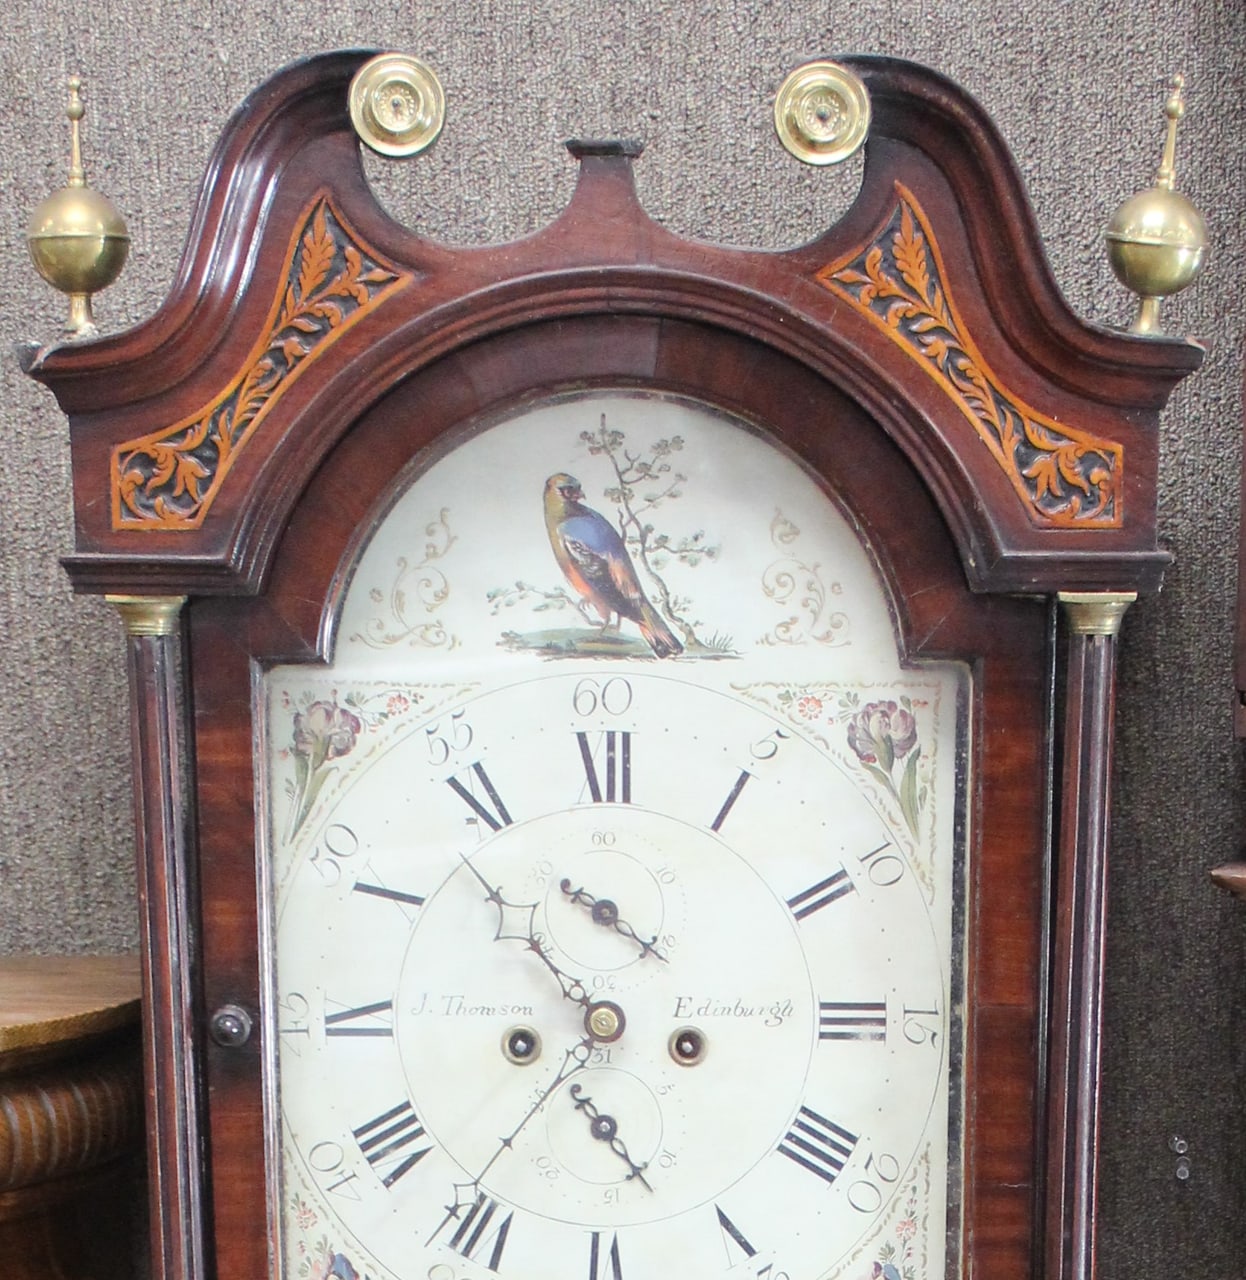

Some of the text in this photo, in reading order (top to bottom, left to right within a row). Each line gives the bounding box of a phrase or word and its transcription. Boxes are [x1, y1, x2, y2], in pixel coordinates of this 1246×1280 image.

[573, 677, 633, 716] 60
[426, 708, 473, 766] 55
[749, 729, 790, 760] 5
[572, 730, 641, 806] XII
[445, 759, 519, 845] XI
[310, 823, 359, 887] 50
[592, 831, 616, 846] 60
[857, 834, 905, 886] 10
[351, 858, 429, 930] X
[656, 866, 676, 885] 10
[783, 861, 860, 928] II
[441, 995, 533, 1016] Thomson
[592, 975, 616, 990] 30
[279, 992, 310, 1057] 45
[324, 990, 395, 1045] IX
[673, 996, 795, 1027] Edinburgh
[818, 994, 887, 1047] III
[903, 1000, 939, 1048] 15
[591, 1047, 613, 1064] 31
[350, 1091, 435, 1192] VIII
[536, 1156, 560, 1180] 20
[308, 1141, 362, 1201] 40
[847, 1151, 900, 1213] 20
